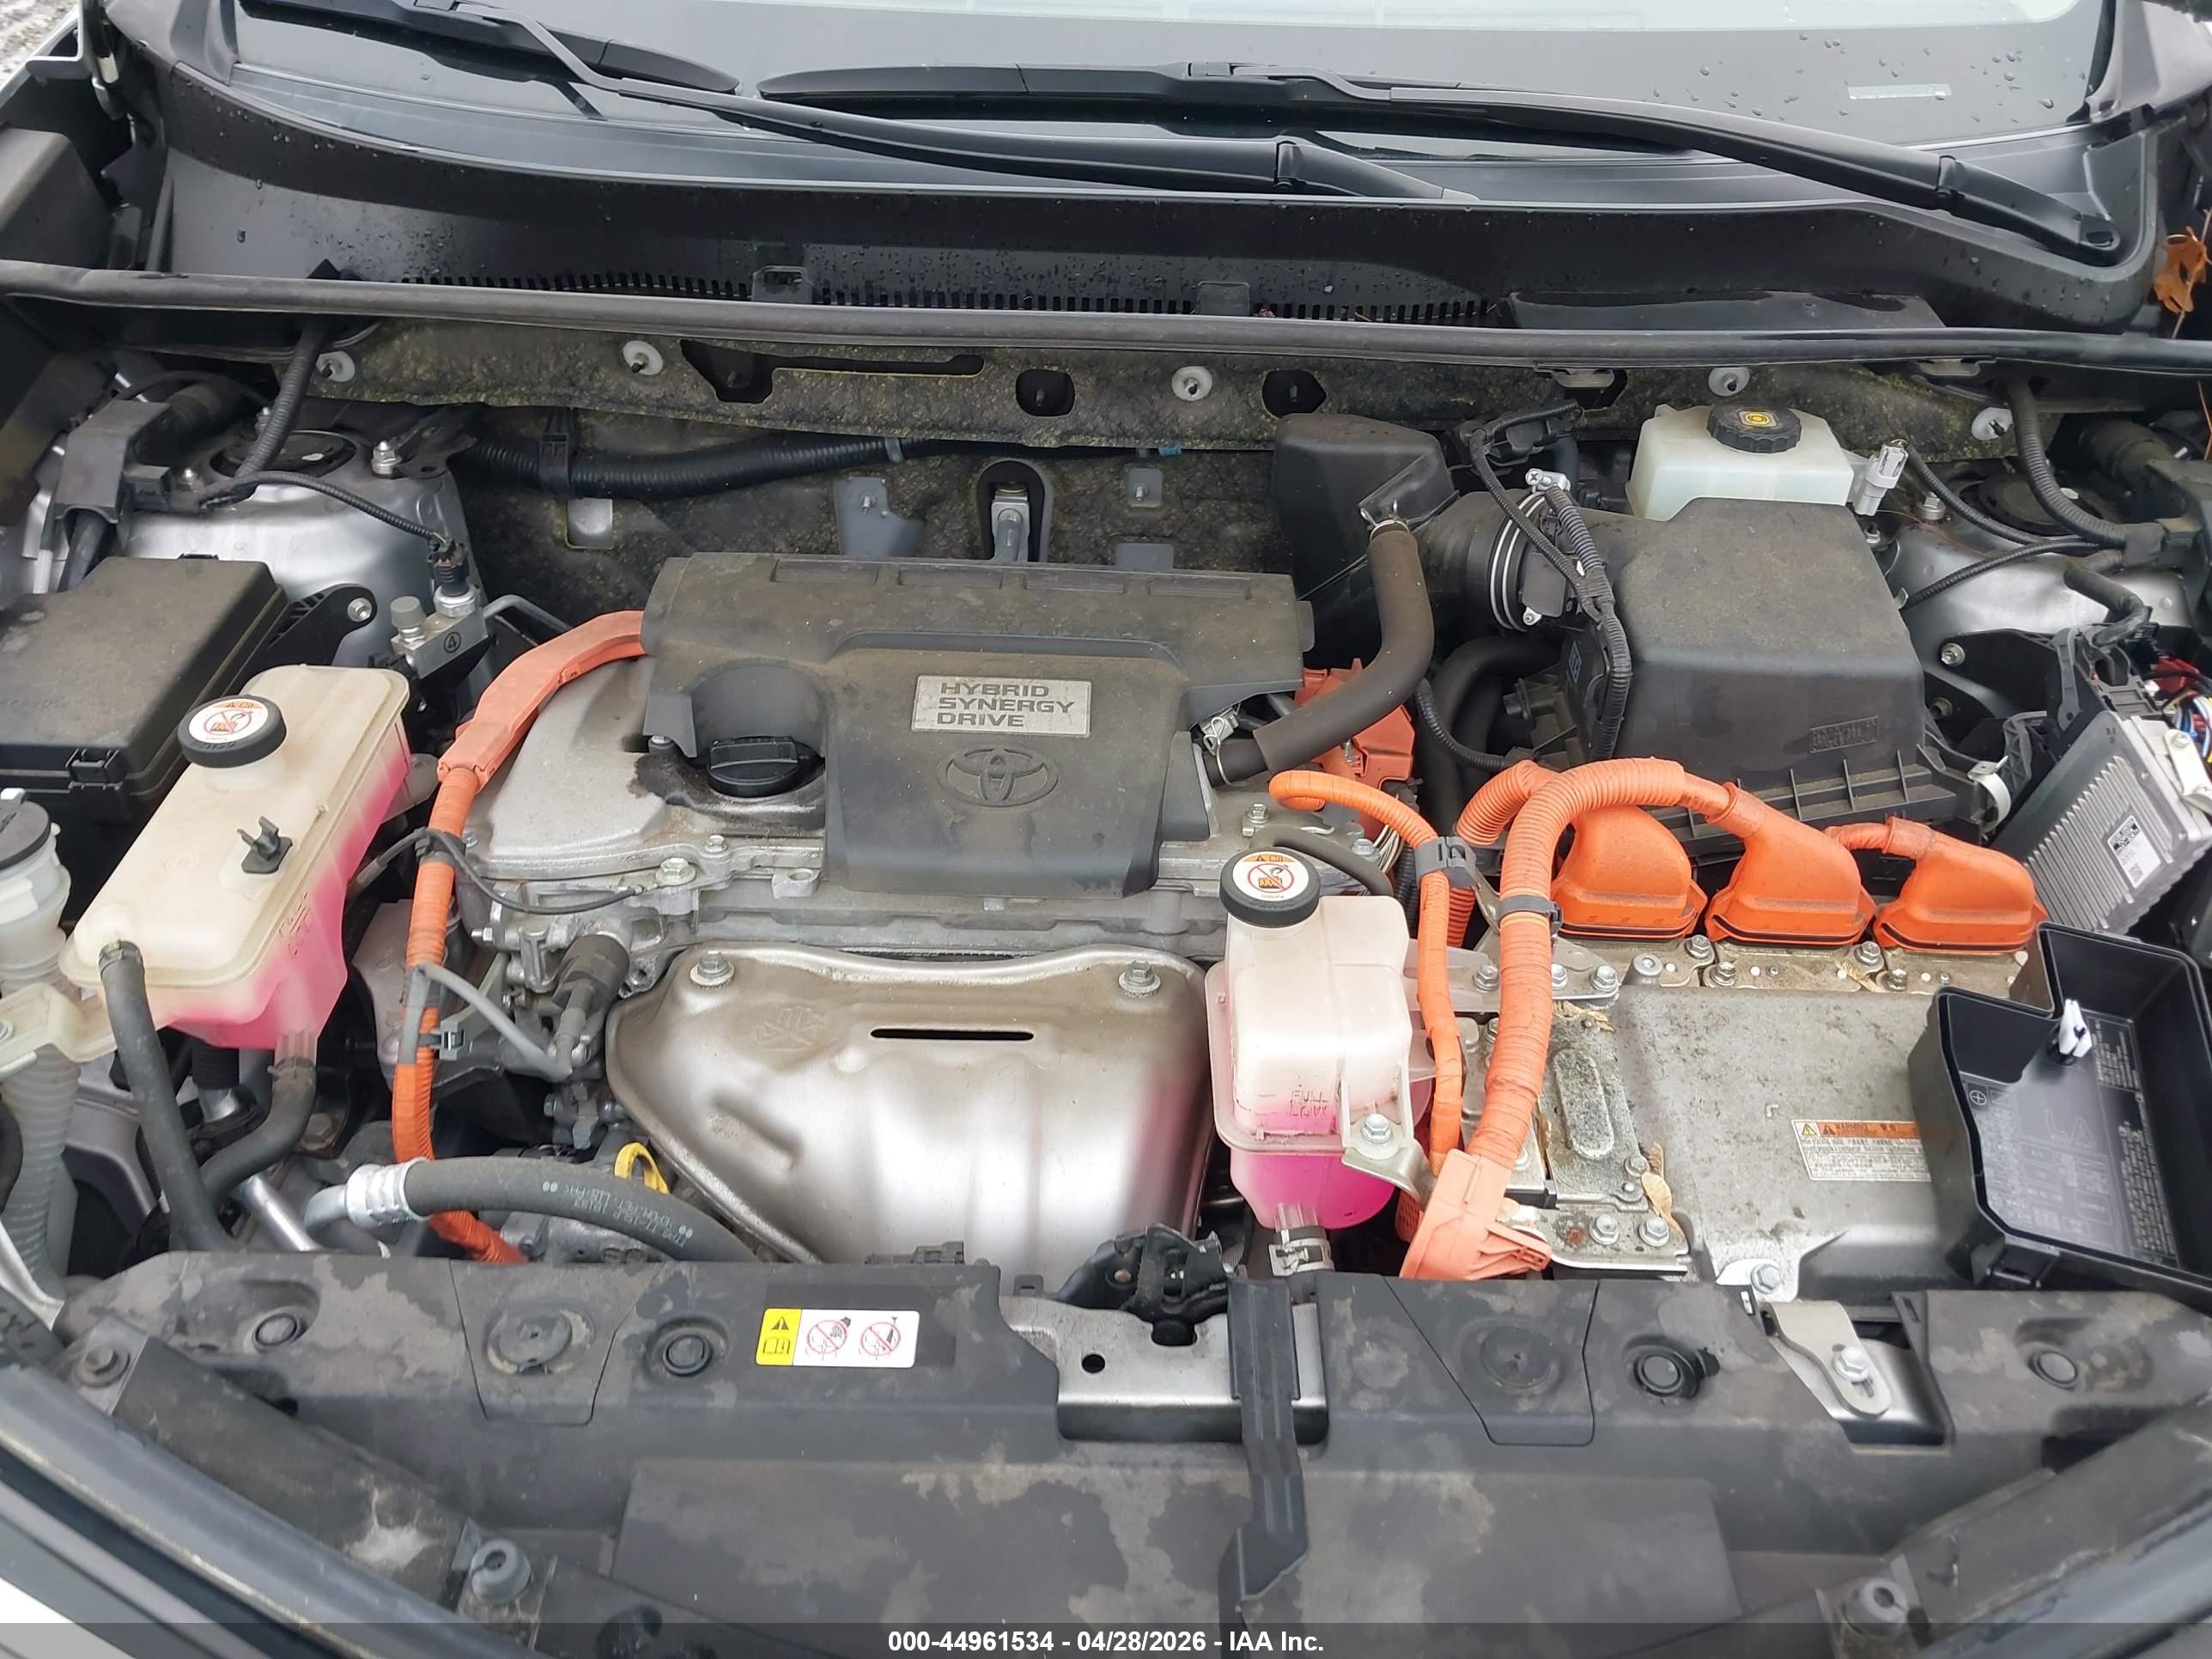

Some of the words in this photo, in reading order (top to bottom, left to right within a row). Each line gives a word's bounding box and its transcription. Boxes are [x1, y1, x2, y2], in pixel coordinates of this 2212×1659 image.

[941, 683, 1049, 696] HYBRID
[939, 697, 1075, 713] SYNERGY
[937, 713, 1024, 726] DRIVE
[1291, 1089, 1328, 1103] FULL
